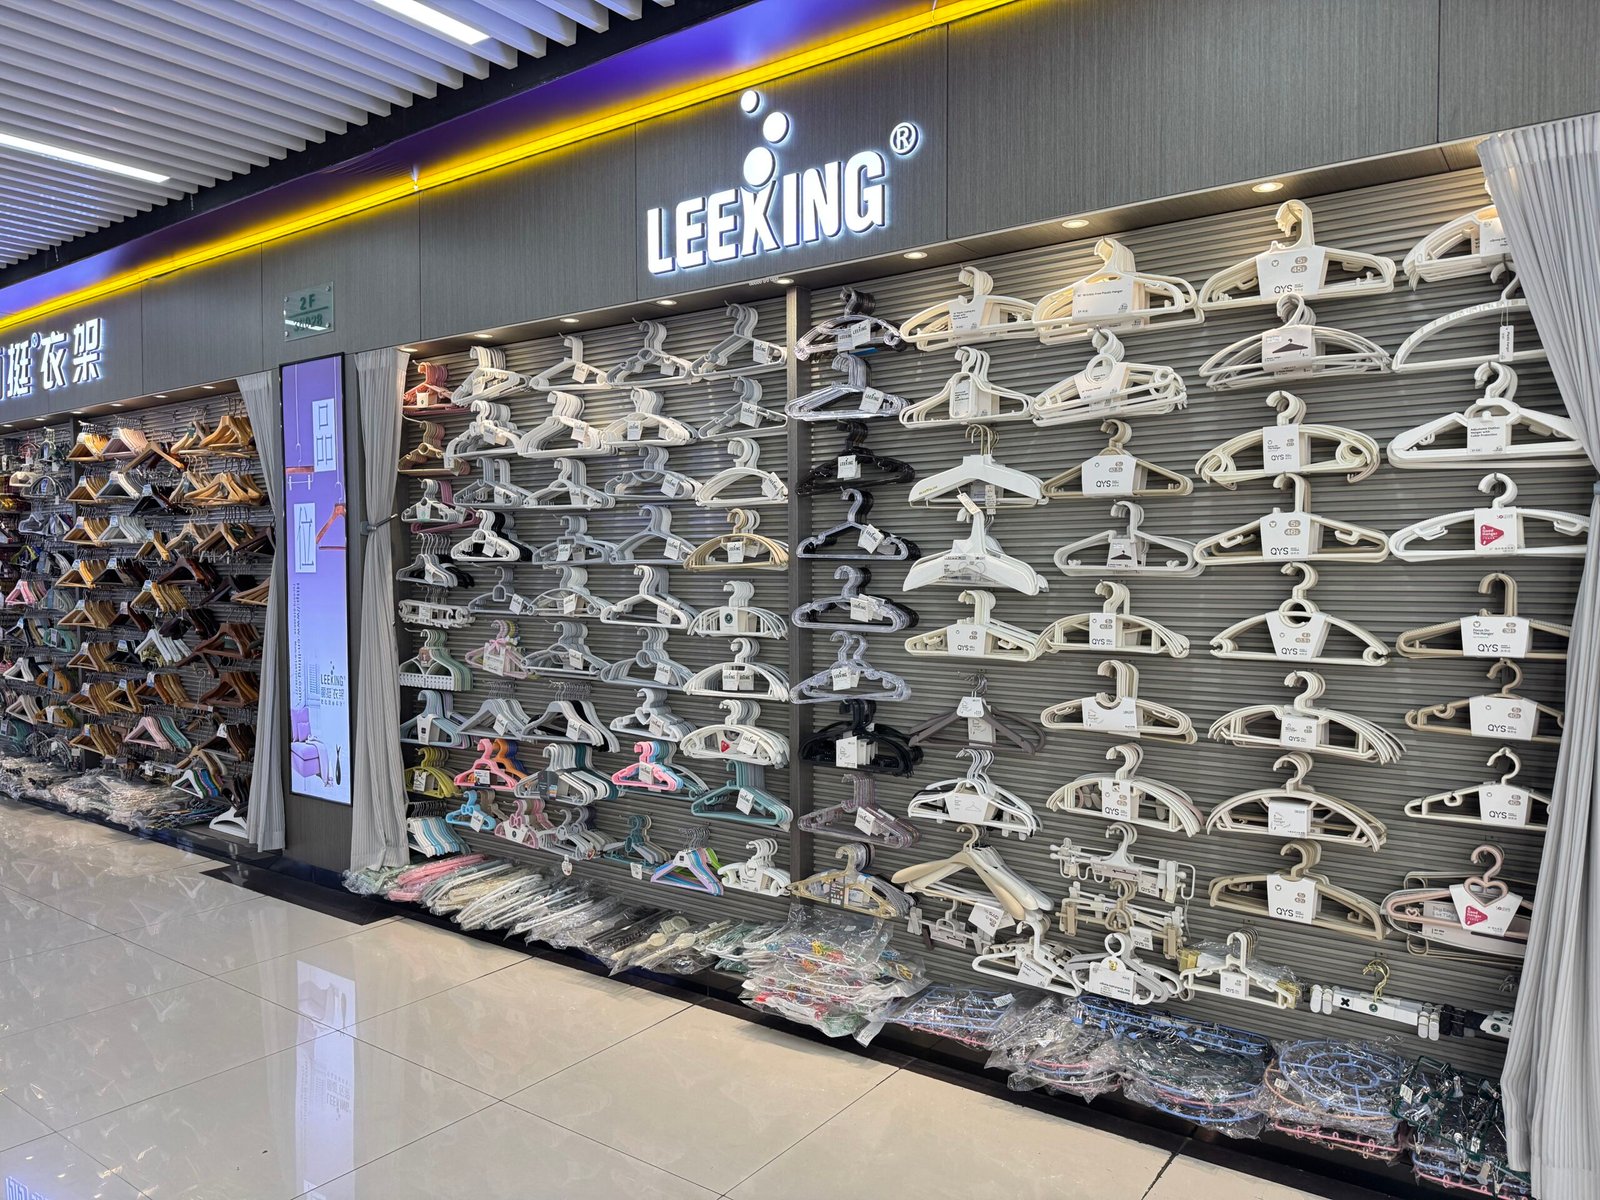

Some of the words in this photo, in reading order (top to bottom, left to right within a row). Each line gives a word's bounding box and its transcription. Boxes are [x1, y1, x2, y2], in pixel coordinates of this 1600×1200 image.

[1274, 284, 1292, 293] QYS
[300, 293, 316, 310] 2F
[1270, 547, 1288, 555] QYS
[1281, 647, 1297, 655] QYS
[1477, 643, 1498, 652] QYS
[1487, 724, 1506, 732] QYS
[1104, 807, 1119, 815] QYS
[1489, 810, 1506, 819] QYS
[1276, 907, 1293, 917] QYS
